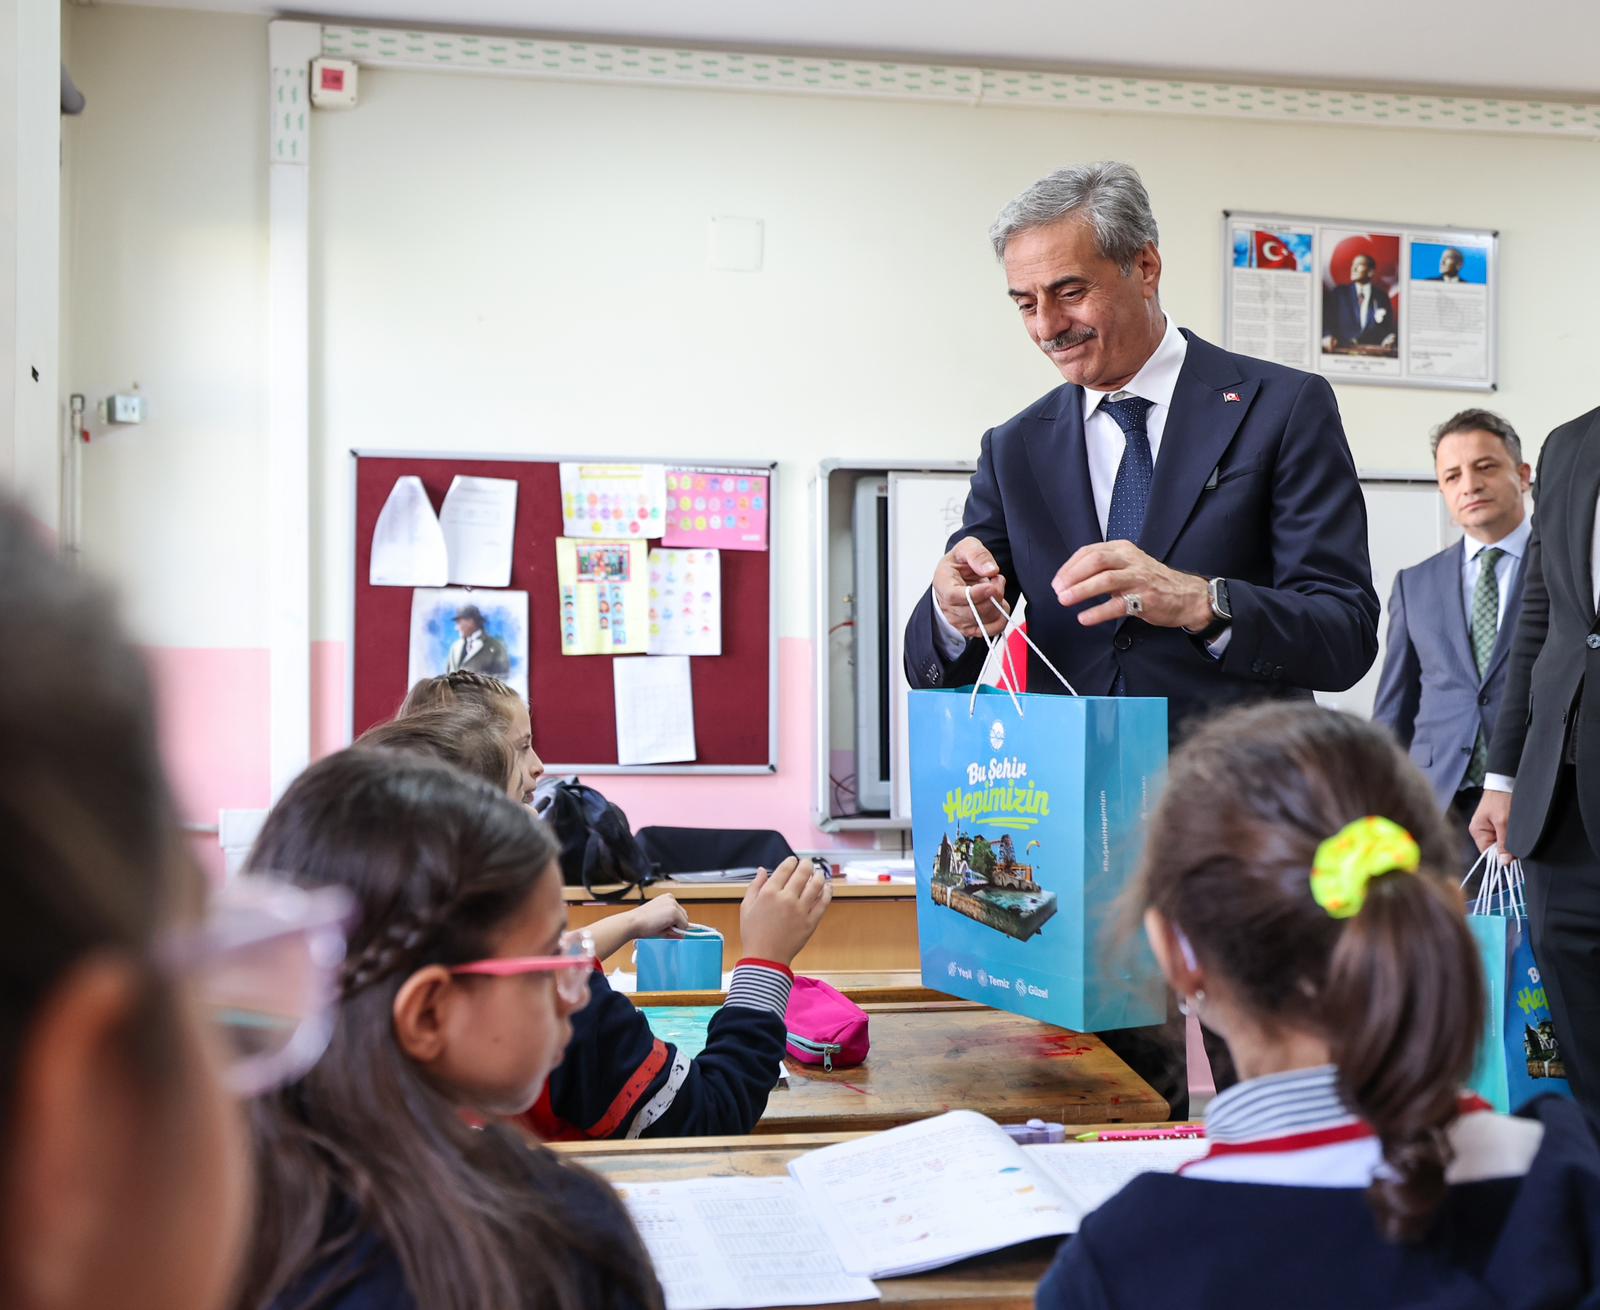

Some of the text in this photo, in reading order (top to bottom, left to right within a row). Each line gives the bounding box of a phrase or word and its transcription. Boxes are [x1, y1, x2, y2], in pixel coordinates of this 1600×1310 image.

[966, 756, 1027, 787] Bu Şehir
[943, 779, 1050, 823] Hepimizin
[988, 975, 1010, 989] Temiz
